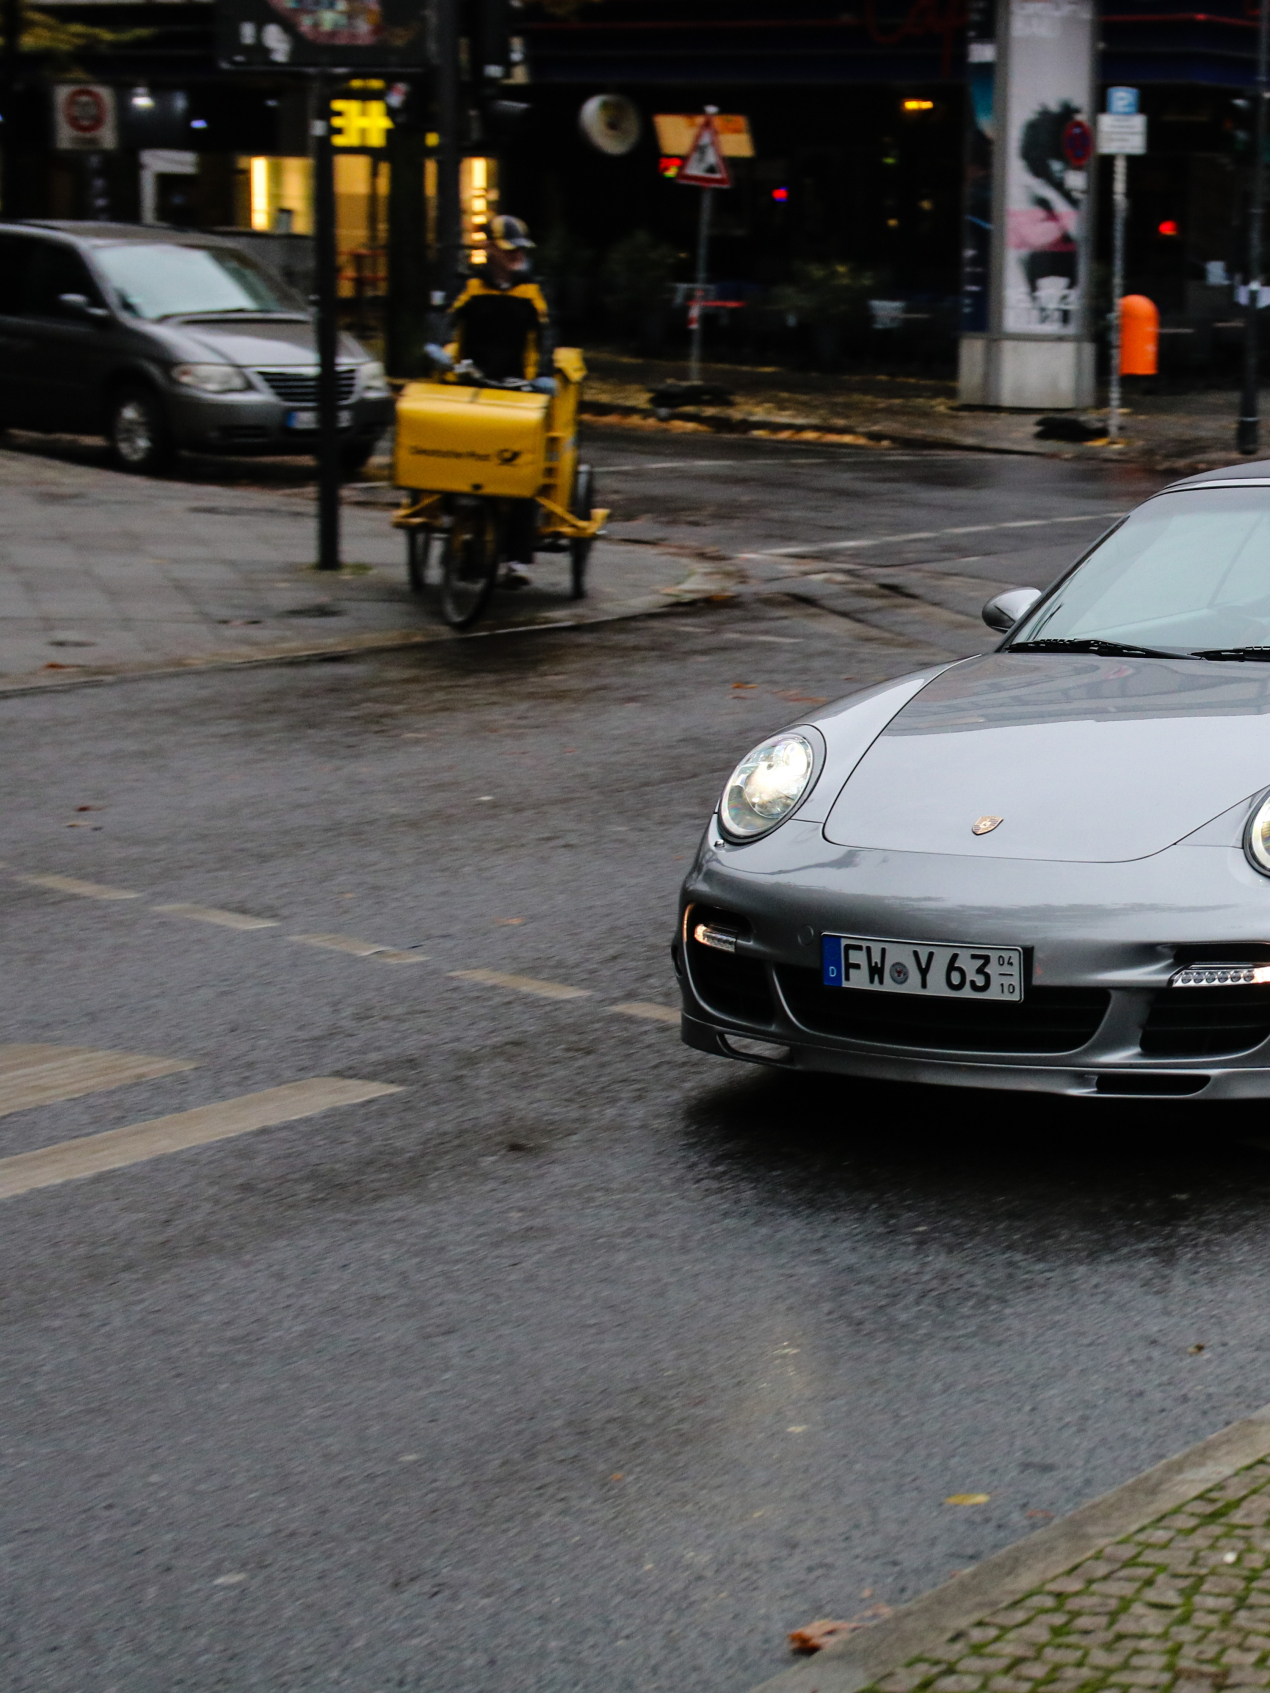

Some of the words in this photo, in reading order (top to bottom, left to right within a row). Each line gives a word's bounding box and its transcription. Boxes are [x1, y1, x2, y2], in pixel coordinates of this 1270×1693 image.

[843, 943, 886, 985] FW
[912, 949, 935, 989] Y
[945, 952, 991, 993] 63
[997, 954, 1014, 968] 04
[999, 982, 1015, 995] 10
